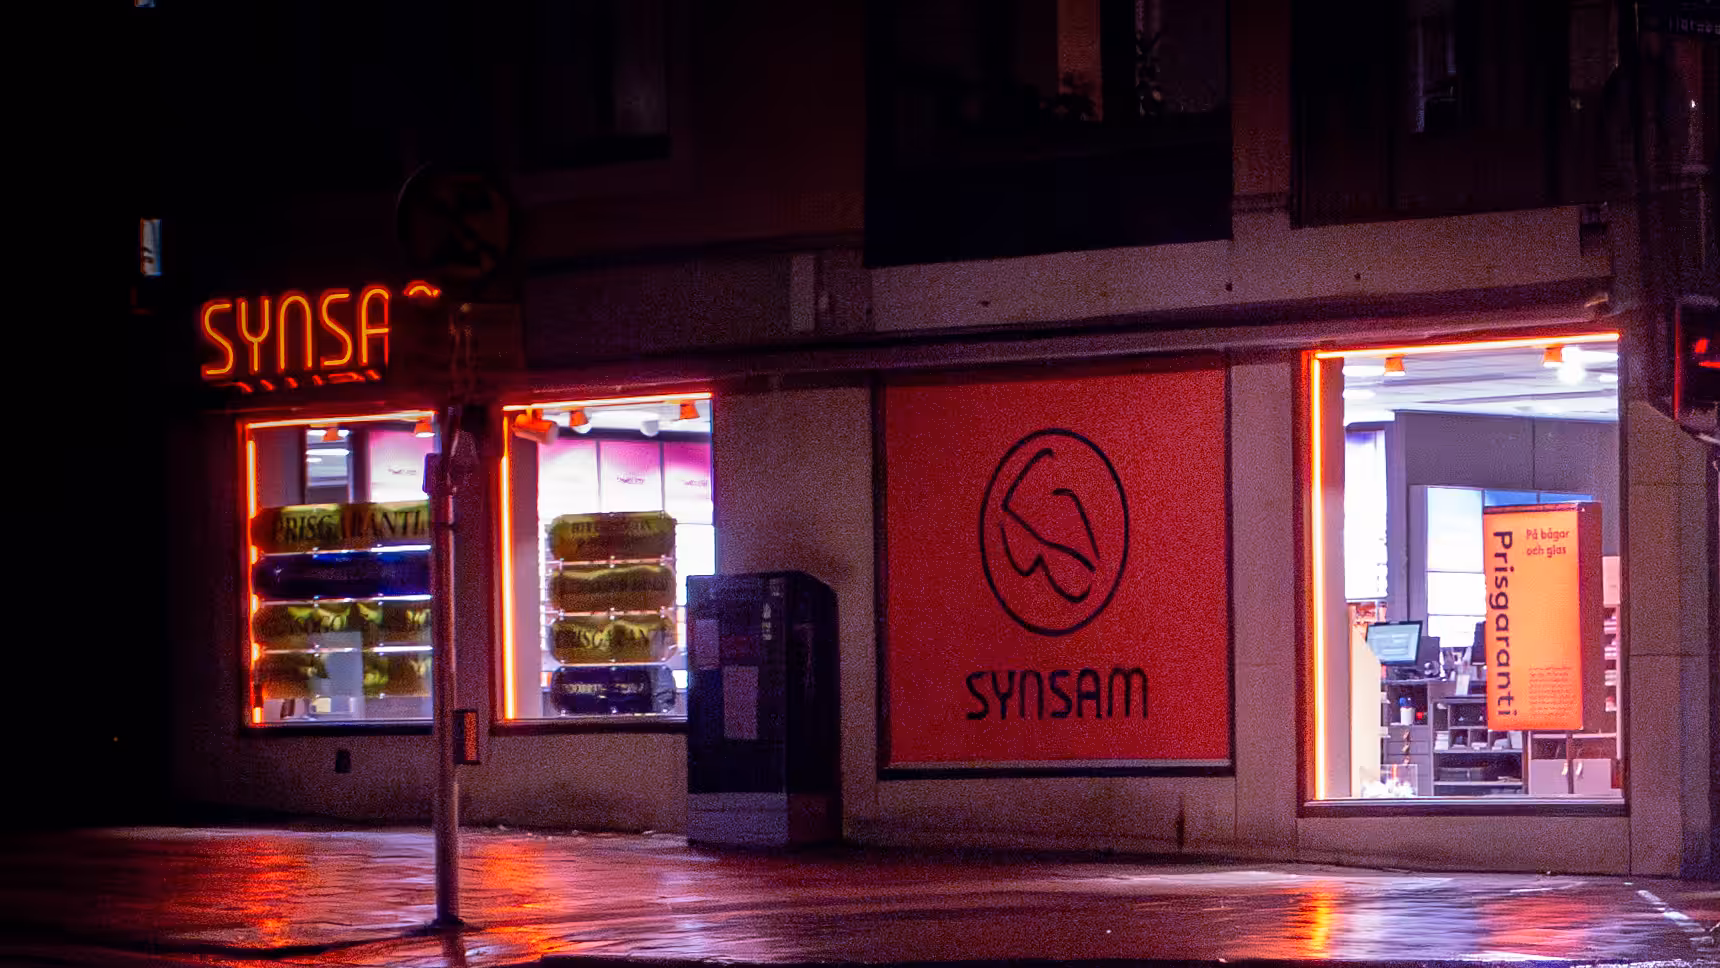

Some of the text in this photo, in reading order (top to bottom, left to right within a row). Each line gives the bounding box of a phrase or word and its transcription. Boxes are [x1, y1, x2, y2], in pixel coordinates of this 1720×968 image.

[202, 279, 441, 379] SYNSA
[1489, 531, 1517, 716] Prisgaranti
[965, 667, 1148, 720] SYNSAM
